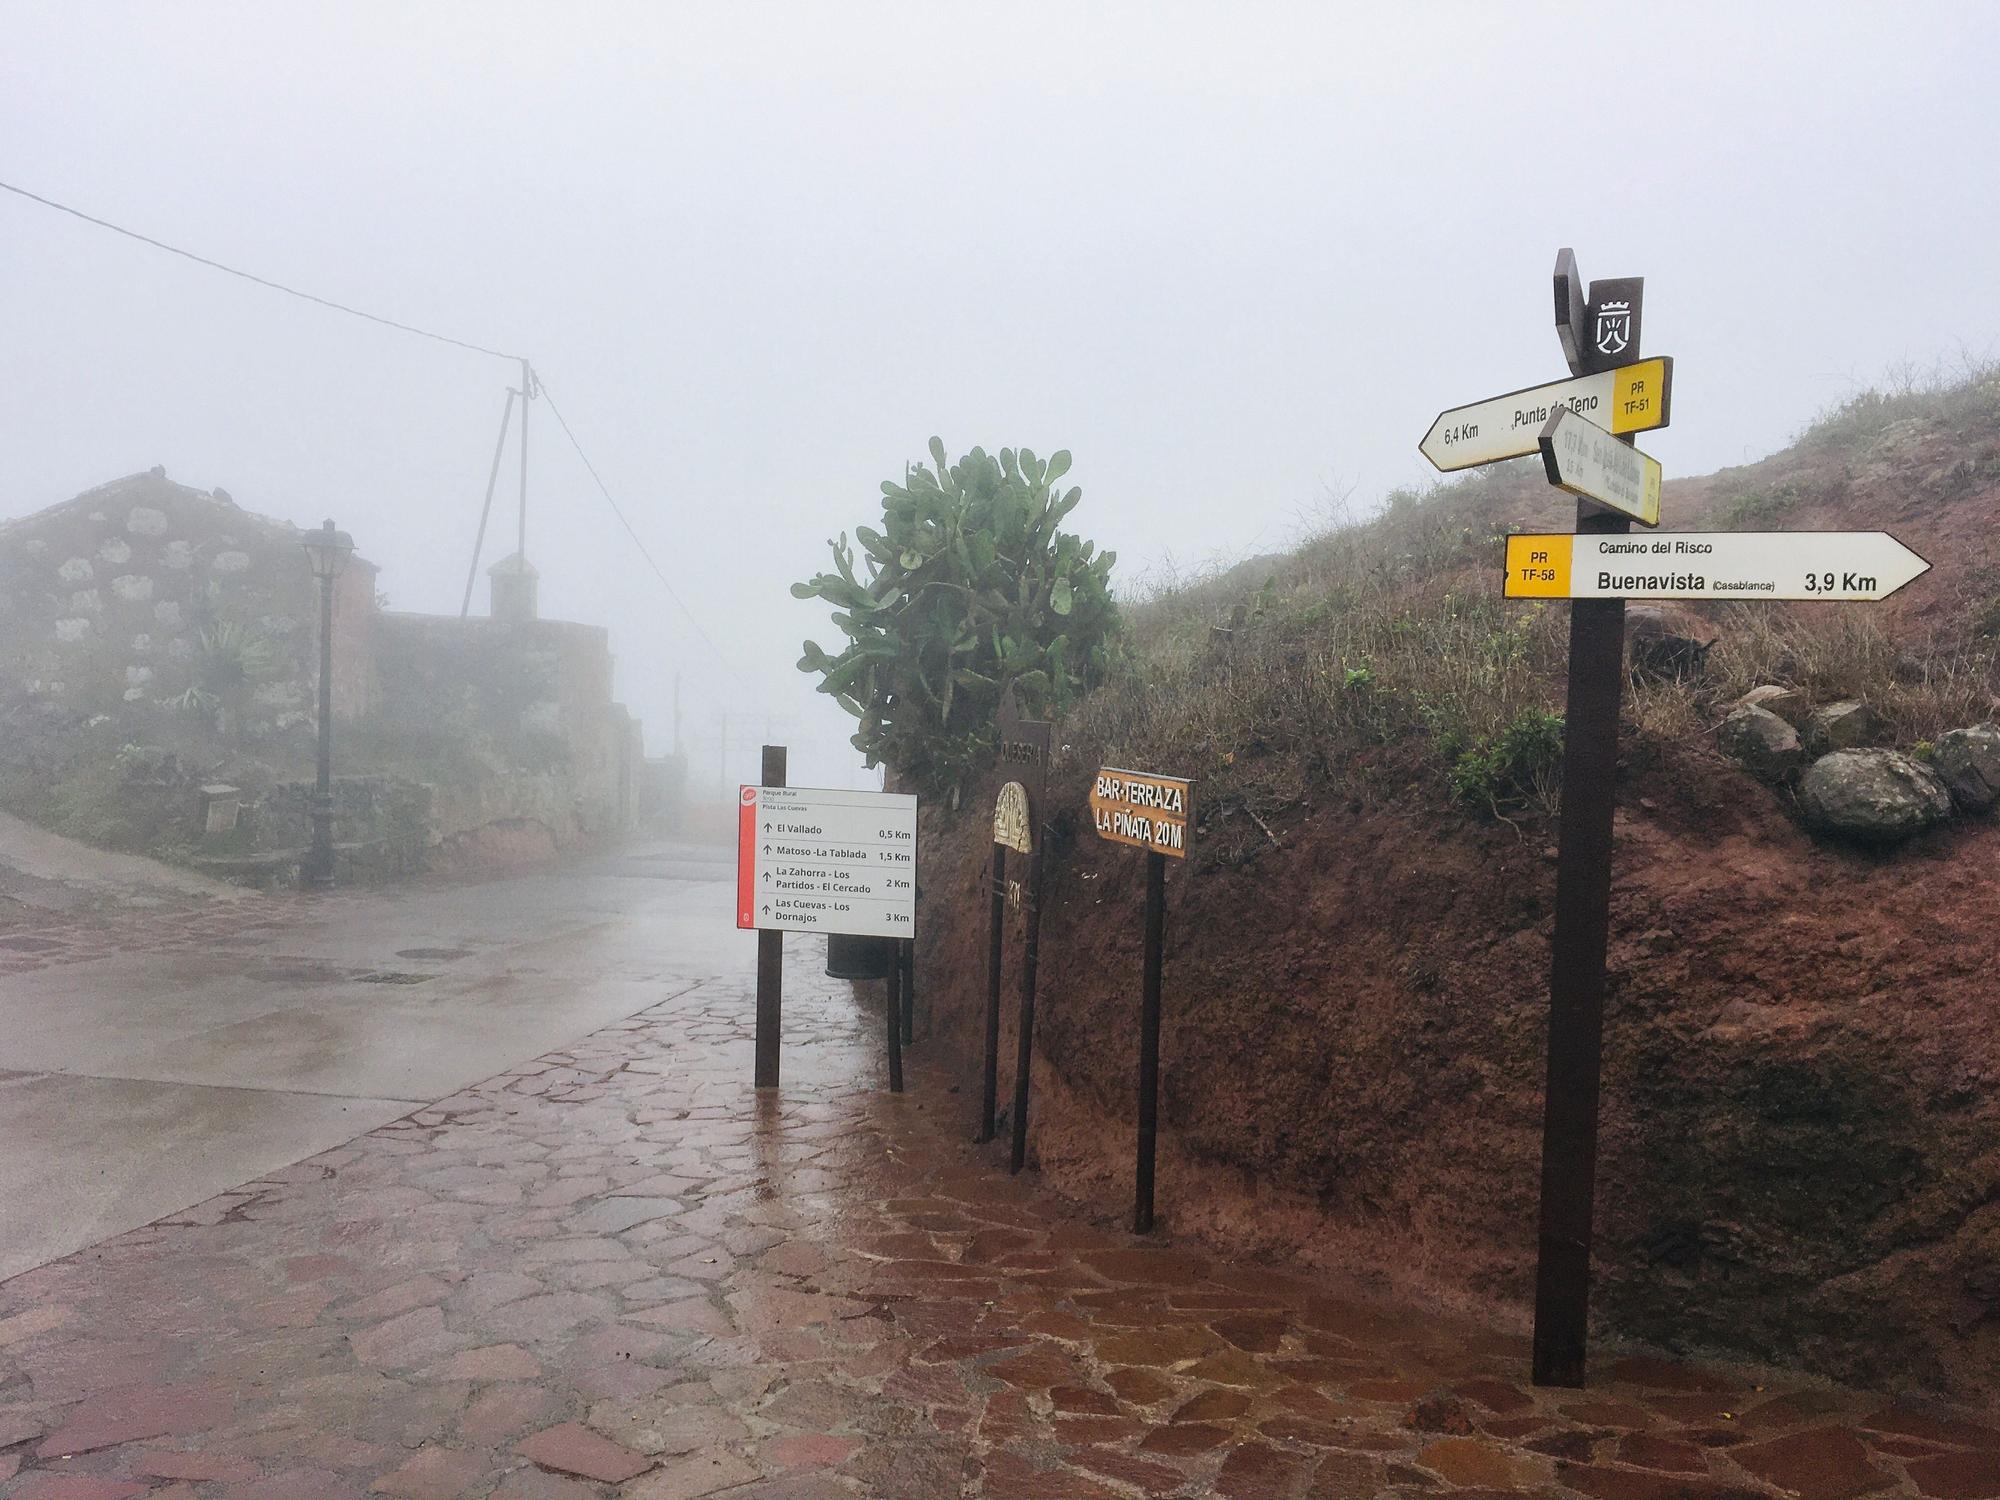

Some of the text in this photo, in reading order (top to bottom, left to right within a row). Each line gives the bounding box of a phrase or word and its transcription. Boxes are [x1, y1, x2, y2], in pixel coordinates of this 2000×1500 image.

[1631, 381, 1644, 395] PR
[1514, 406, 1547, 428] Punta
[1568, 395, 1599, 415] Teno
[1624, 399, 1650, 416] TF-51
[1444, 423, 1479, 448] 6,4 Km
[1599, 542, 1713, 554] Camino del Risco
[1530, 552, 1548, 565] PR
[1521, 568, 1556, 582] TF-58
[1598, 572, 1877, 595] Buenavista (Casablanca) 3,9 Km
[1096, 808, 1111, 831] LA
[1114, 809, 1152, 841] PIÑATA
[777, 824, 911, 840] El Vallado 0,5 Km
[776, 846, 811, 856] Matoso
[829, 849, 867, 860] Tablada
[879, 852, 892, 862] 1,5
[894, 852, 910, 863] Km
[776, 867, 787, 876] La
[789, 867, 826, 878] Zahorra
[834, 871, 850, 880] Los
[776, 880, 815, 891] Partidos
[822, 883, 830, 892] El
[833, 883, 871, 894] Cercado
[886, 879, 910, 889] 2 Km
[776, 899, 791, 908] Las
[793, 900, 827, 911] Cuevas
[834, 903, 850, 912] Los
[775, 912, 909, 923] Dornajos 3 Km
